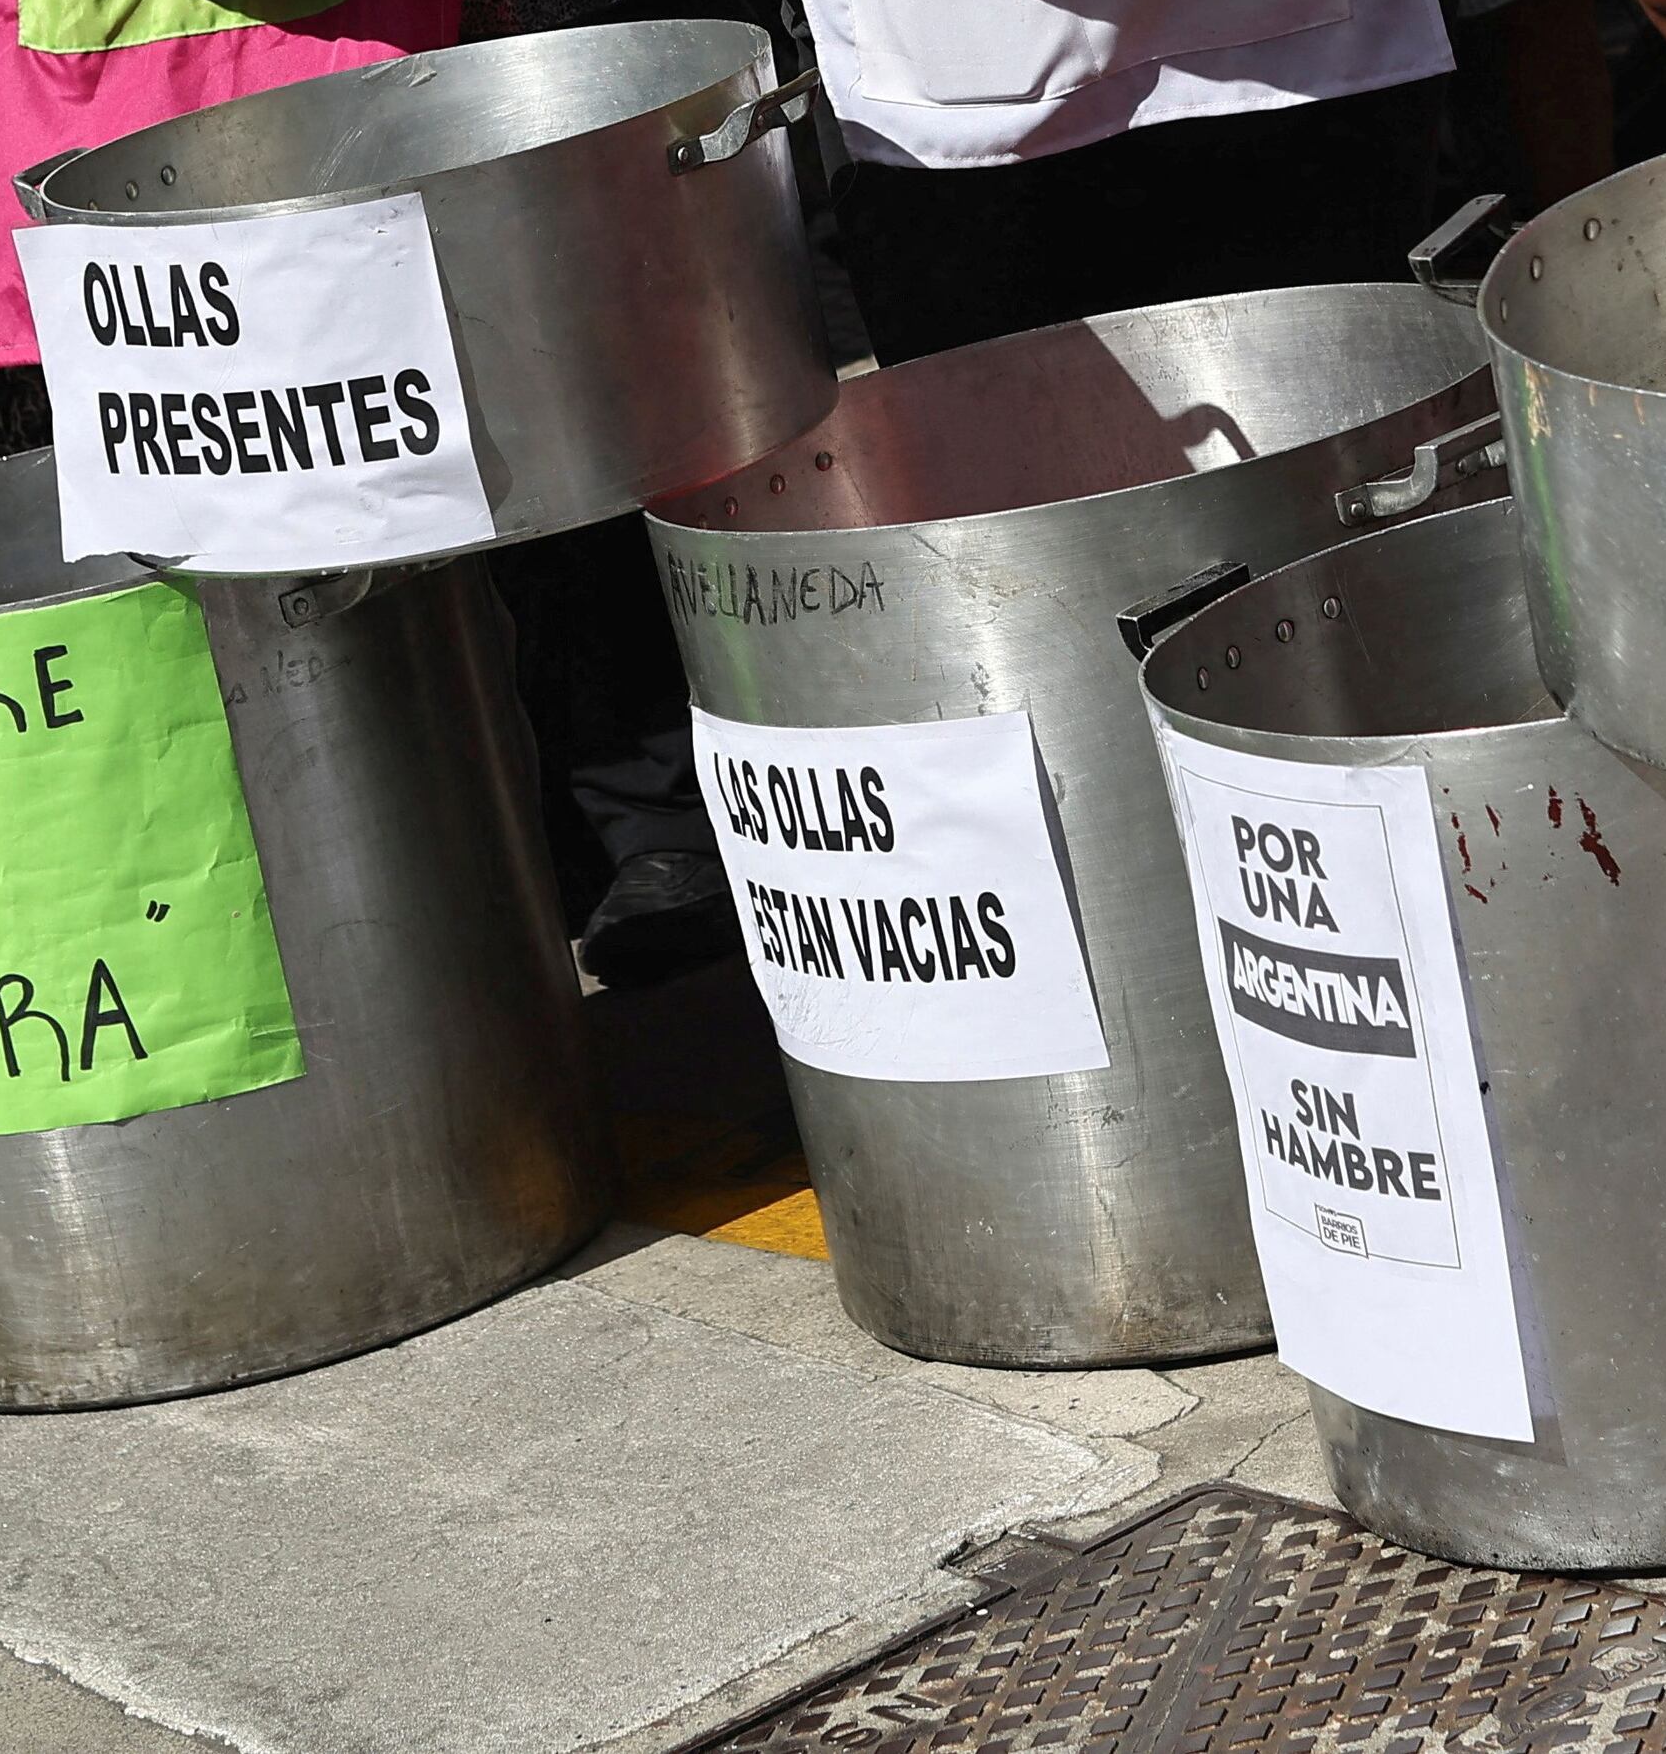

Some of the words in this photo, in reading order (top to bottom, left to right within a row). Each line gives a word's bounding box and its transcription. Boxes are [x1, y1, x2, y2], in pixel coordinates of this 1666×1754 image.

[83, 261, 241, 348] OLLAS
[98, 368, 441, 477] PRESENTES
[713, 751, 770, 846] LAS
[766, 764, 895, 853] OLLAS
[1231, 814, 1328, 880] POR
[745, 877, 846, 980] ESTAN
[841, 891, 1017, 985] VACIAS
[1241, 868, 1341, 934] UNA
[1232, 941, 1410, 1030] ARGENTINA
[1290, 1078, 1360, 1141] SIN
[1260, 1108, 1443, 1201] HAMBRE
[1321, 1215, 1358, 1235] BARRIOS
[1323, 1226, 1339, 1243] DE
[1341, 1233, 1361, 1249] PIE
